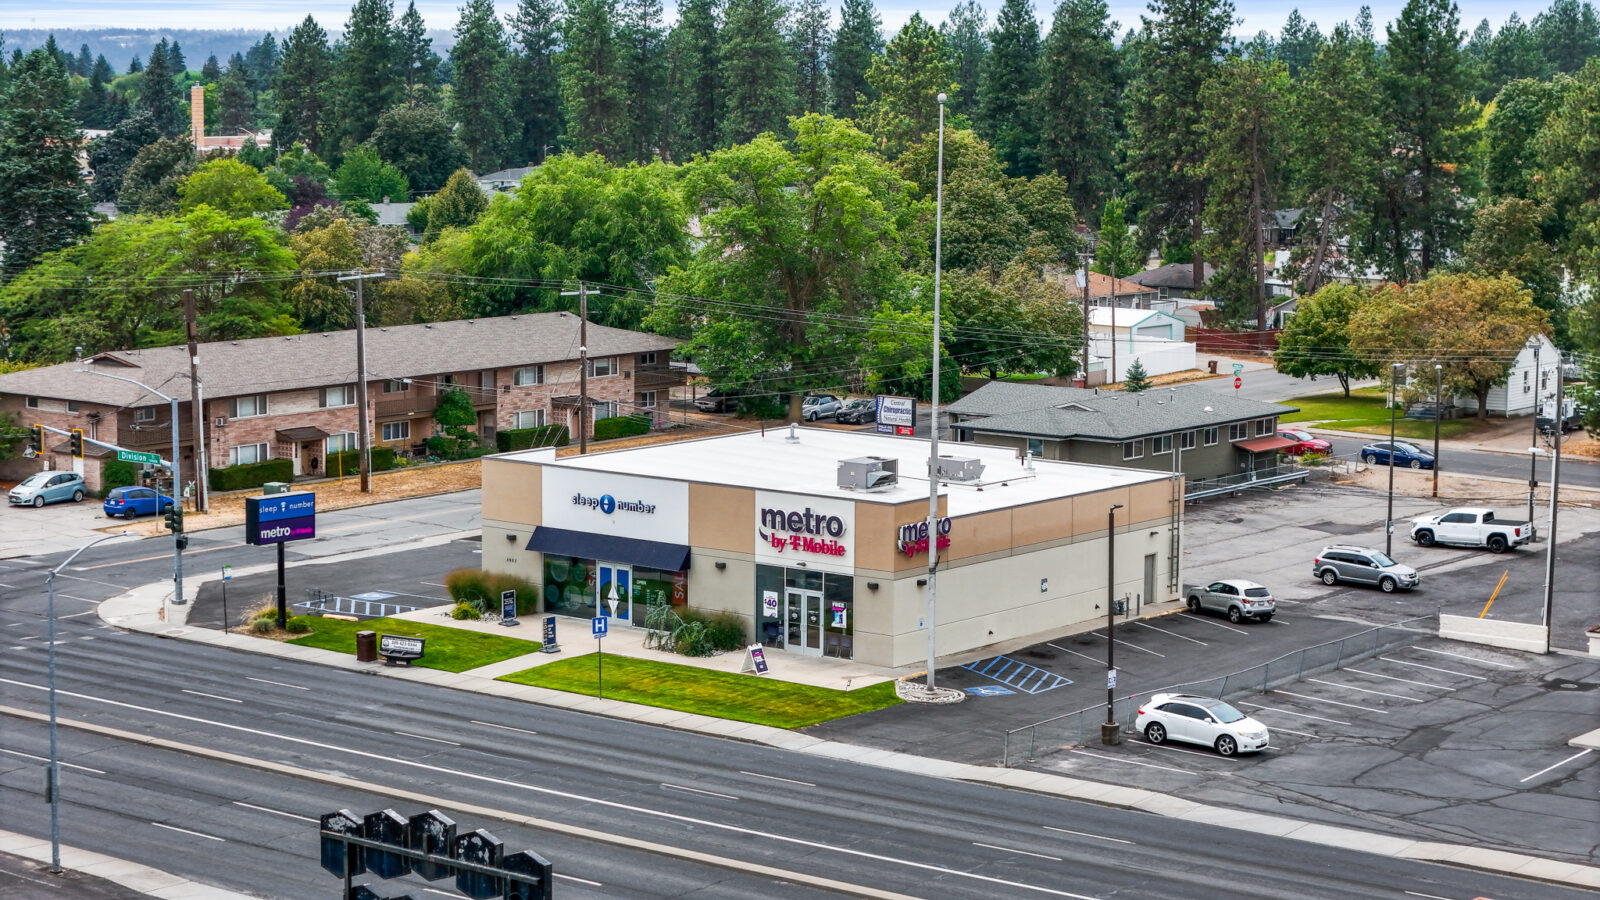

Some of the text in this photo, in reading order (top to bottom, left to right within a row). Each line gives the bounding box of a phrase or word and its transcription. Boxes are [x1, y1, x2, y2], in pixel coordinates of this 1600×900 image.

[883, 405, 912, 415] Chiropractic
[121, 451, 147, 461] Division
[259, 501, 314, 514] sleep number
[572, 492, 656, 514] sleep number
[761, 507, 846, 538] metro
[902, 517, 952, 541] mero
[260, 526, 291, 539] metro
[771, 532, 787, 553] by
[674, 573, 684, 600] SAL
[764, 598, 778, 608] $40
[595, 619, 605, 632] H
